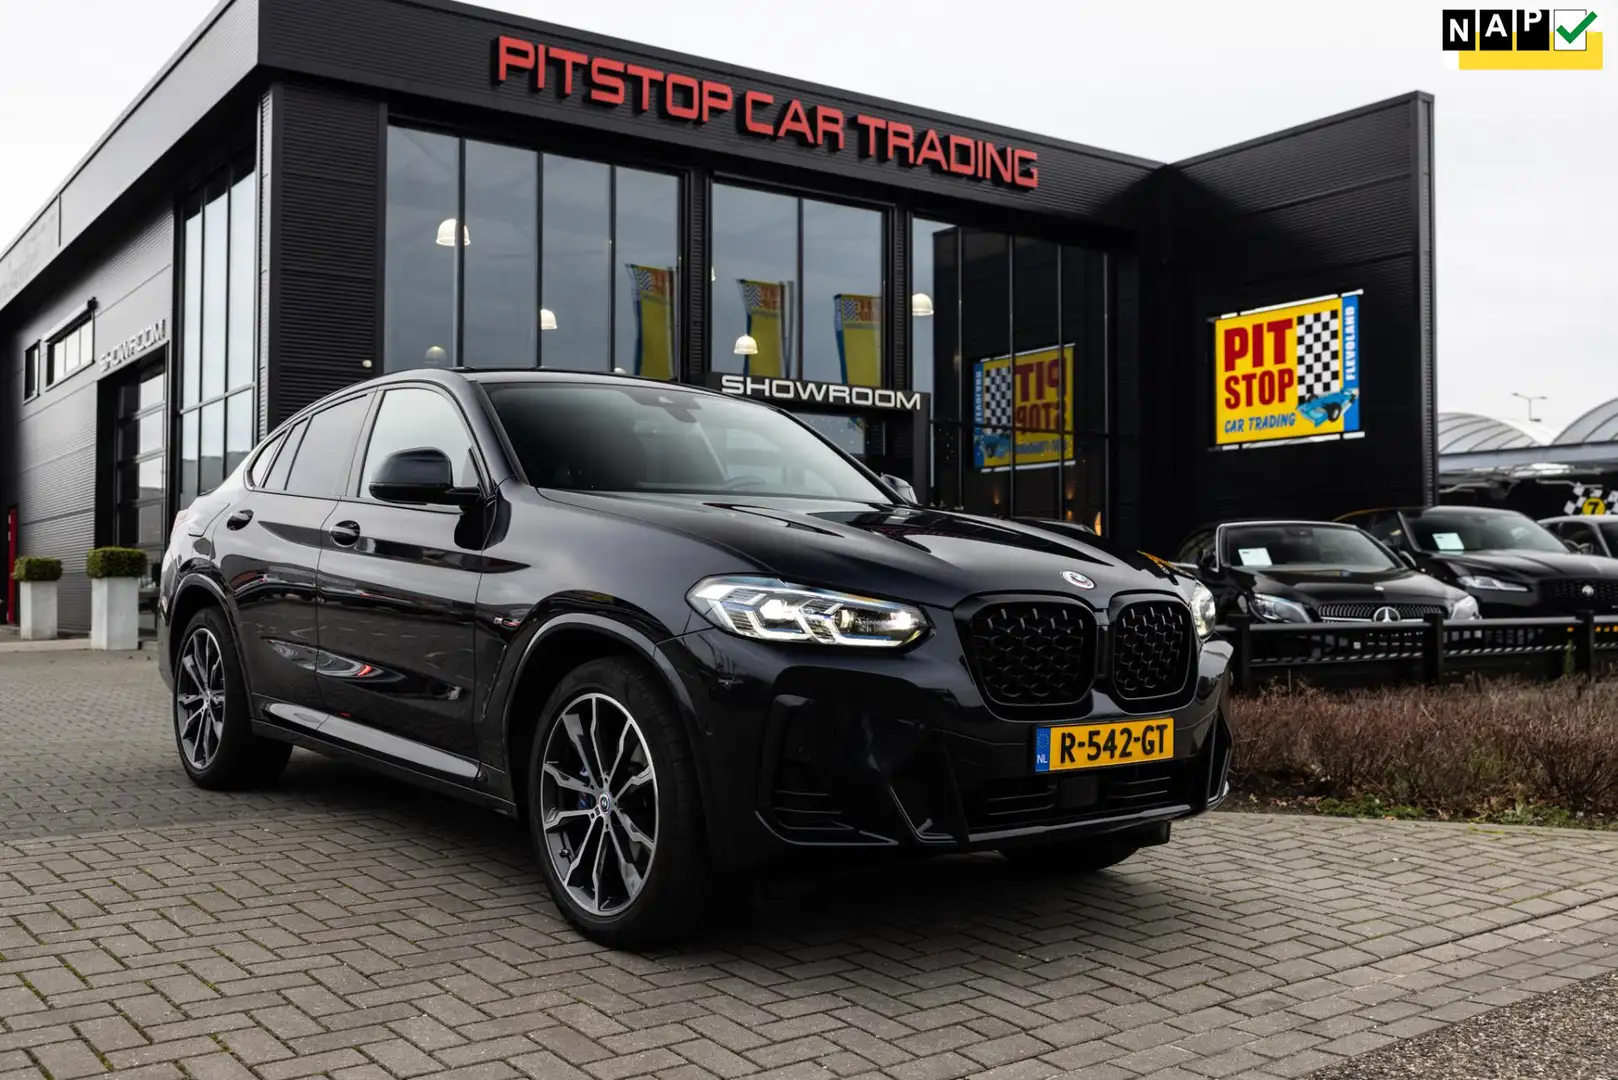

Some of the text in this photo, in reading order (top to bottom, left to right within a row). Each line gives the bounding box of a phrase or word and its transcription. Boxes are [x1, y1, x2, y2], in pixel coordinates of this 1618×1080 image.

[498, 35, 1039, 188] PITSTOP CAR TRADING
[1224, 317, 1294, 373] PIT
[1344, 305, 1356, 381] FLEVOLAND
[721, 375, 921, 410] SHOWROOM
[1224, 368, 1295, 410] STOP
[1224, 412, 1297, 433] CAR TRADING
[1036, 754, 1048, 764] NL
[1059, 723, 1168, 764] R-542-GT
